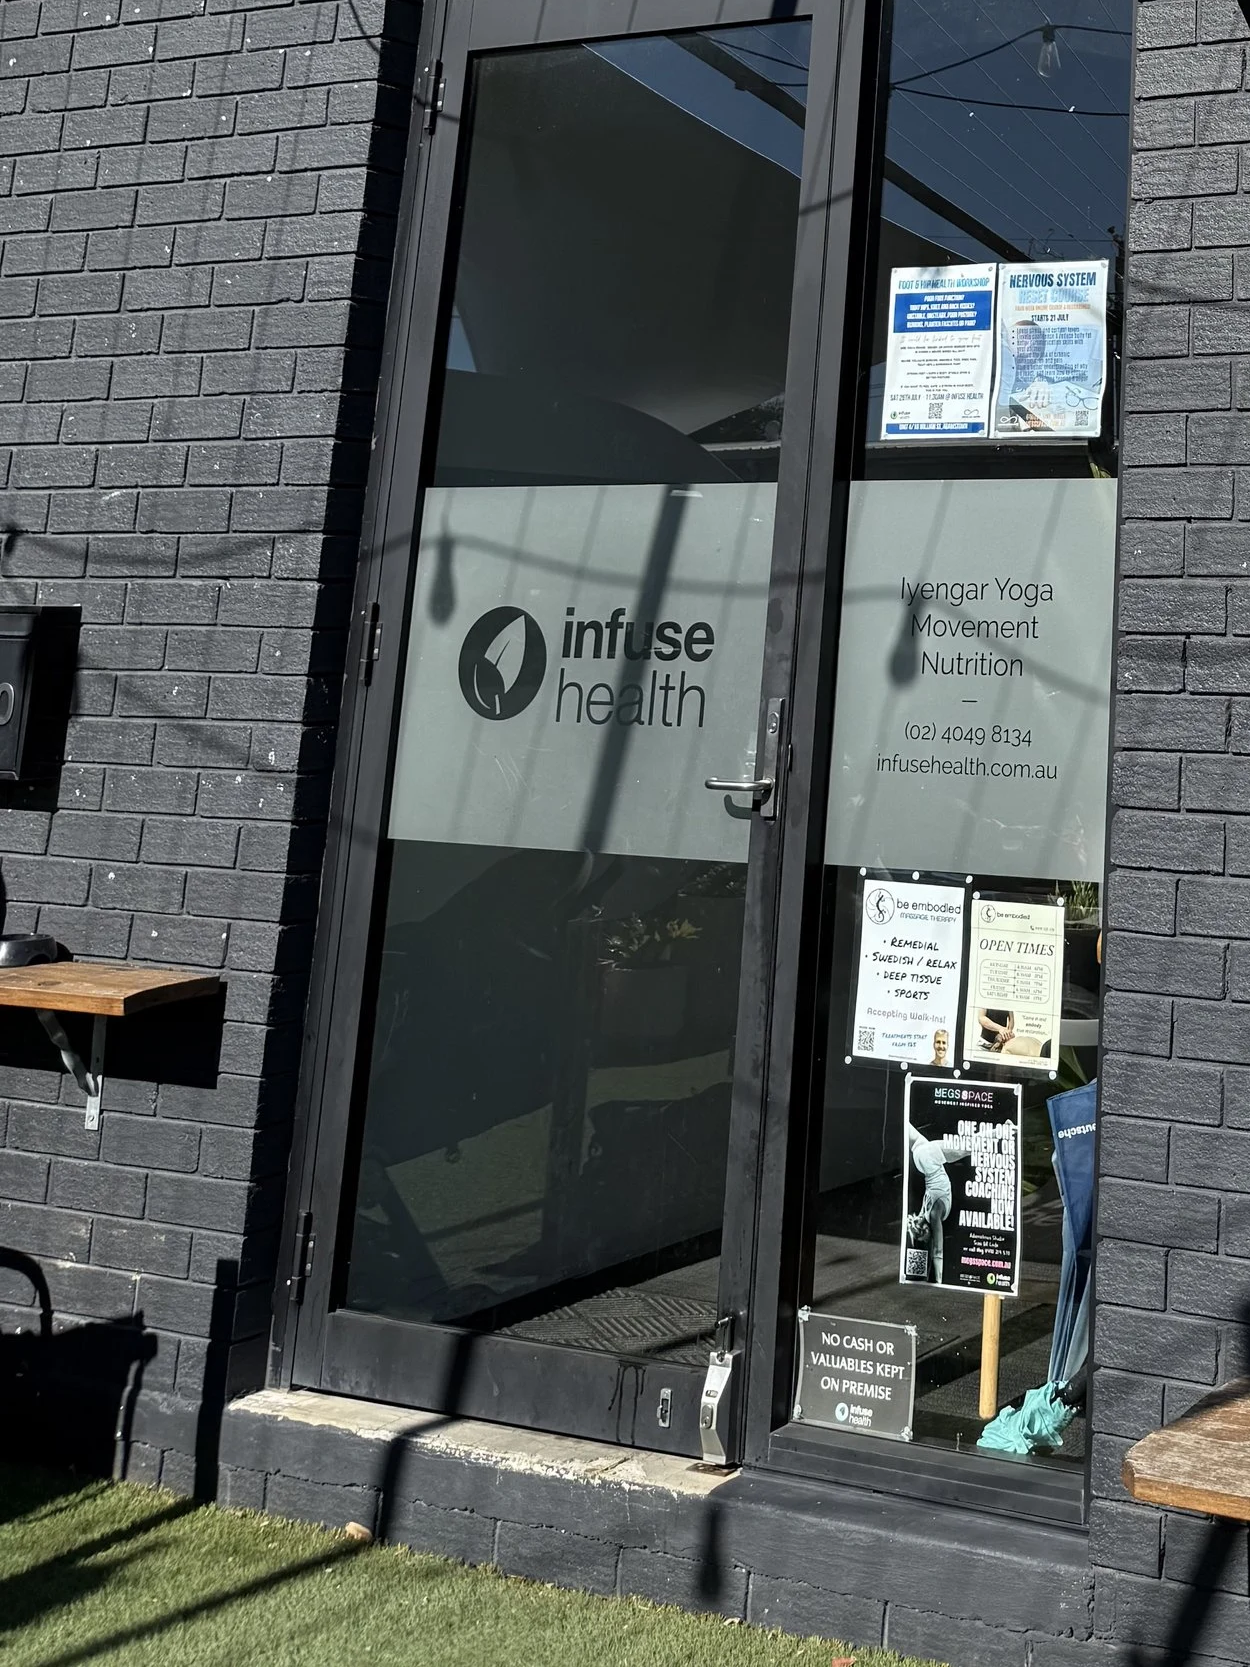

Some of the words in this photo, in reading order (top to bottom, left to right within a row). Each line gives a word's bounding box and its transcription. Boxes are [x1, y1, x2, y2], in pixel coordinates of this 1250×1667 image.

[956, 277, 990, 287] WORKSHOP
[1009, 273, 1054, 288] NERVOUS
[1056, 272, 1097, 287] SYSTEM
[1018, 289, 1048, 304] RESET
[1050, 287, 1090, 303] COURSE
[1031, 314, 1049, 322] STARTS
[1057, 313, 1070, 321] JULY
[901, 577, 989, 607] Iyengar
[995, 578, 1054, 607] Yoga
[562, 607, 715, 662] infuse
[911, 614, 1039, 639] Movement
[921, 651, 1024, 677] Nutrition
[555, 668, 706, 728] health
[904, 721, 937, 742] (02)
[941, 725, 986, 746] 4049
[991, 725, 1033, 747] 8134
[877, 753, 1058, 780] infusehealth.com.au
[896, 898, 909, 909] be
[911, 901, 961, 914] embodied
[900, 912, 929, 921] MASSAGE
[930, 914, 956, 923] THERAPY
[890, 936, 939, 951] REMEDIAL
[979, 938, 1014, 953] OPEN
[1017, 941, 1055, 956] TIMES
[872, 951, 914, 966] SWEDISH
[926, 959, 957, 970] RELAX
[883, 971, 907, 982] DEEP
[910, 973, 943, 985] TISSUE
[894, 989, 930, 1000] SPORTS
[867, 1007, 908, 1021] Accepting
[910, 1012, 946, 1024] Walk-Ins!
[957, 1120, 977, 1137] ONE
[979, 1122, 993, 1138] ON
[996, 1123, 1015, 1141] ONE
[943, 1134, 999, 1153] MOVEMENT
[1001, 1139, 1015, 1154] OR
[970, 1151, 1015, 1170] NERVOUS
[974, 1167, 1015, 1185] SYSTEM
[965, 1180, 1015, 1201] COACHING
[990, 1198, 1015, 1216] NOW
[958, 1210, 1015, 1231] AVAILABLE!
[961, 1256, 1012, 1270] megsspace.com.au
[821, 1331, 841, 1346] NO
[843, 1335, 873, 1352] CASH
[876, 1341, 894, 1356] OR
[811, 1351, 873, 1375] VALUABLES
[876, 1362, 905, 1380] KEPT
[820, 1376, 840, 1392] ON
[842, 1380, 892, 1401] PREMISE
[850, 1404, 873, 1417] infuse
[848, 1414, 872, 1427] health
